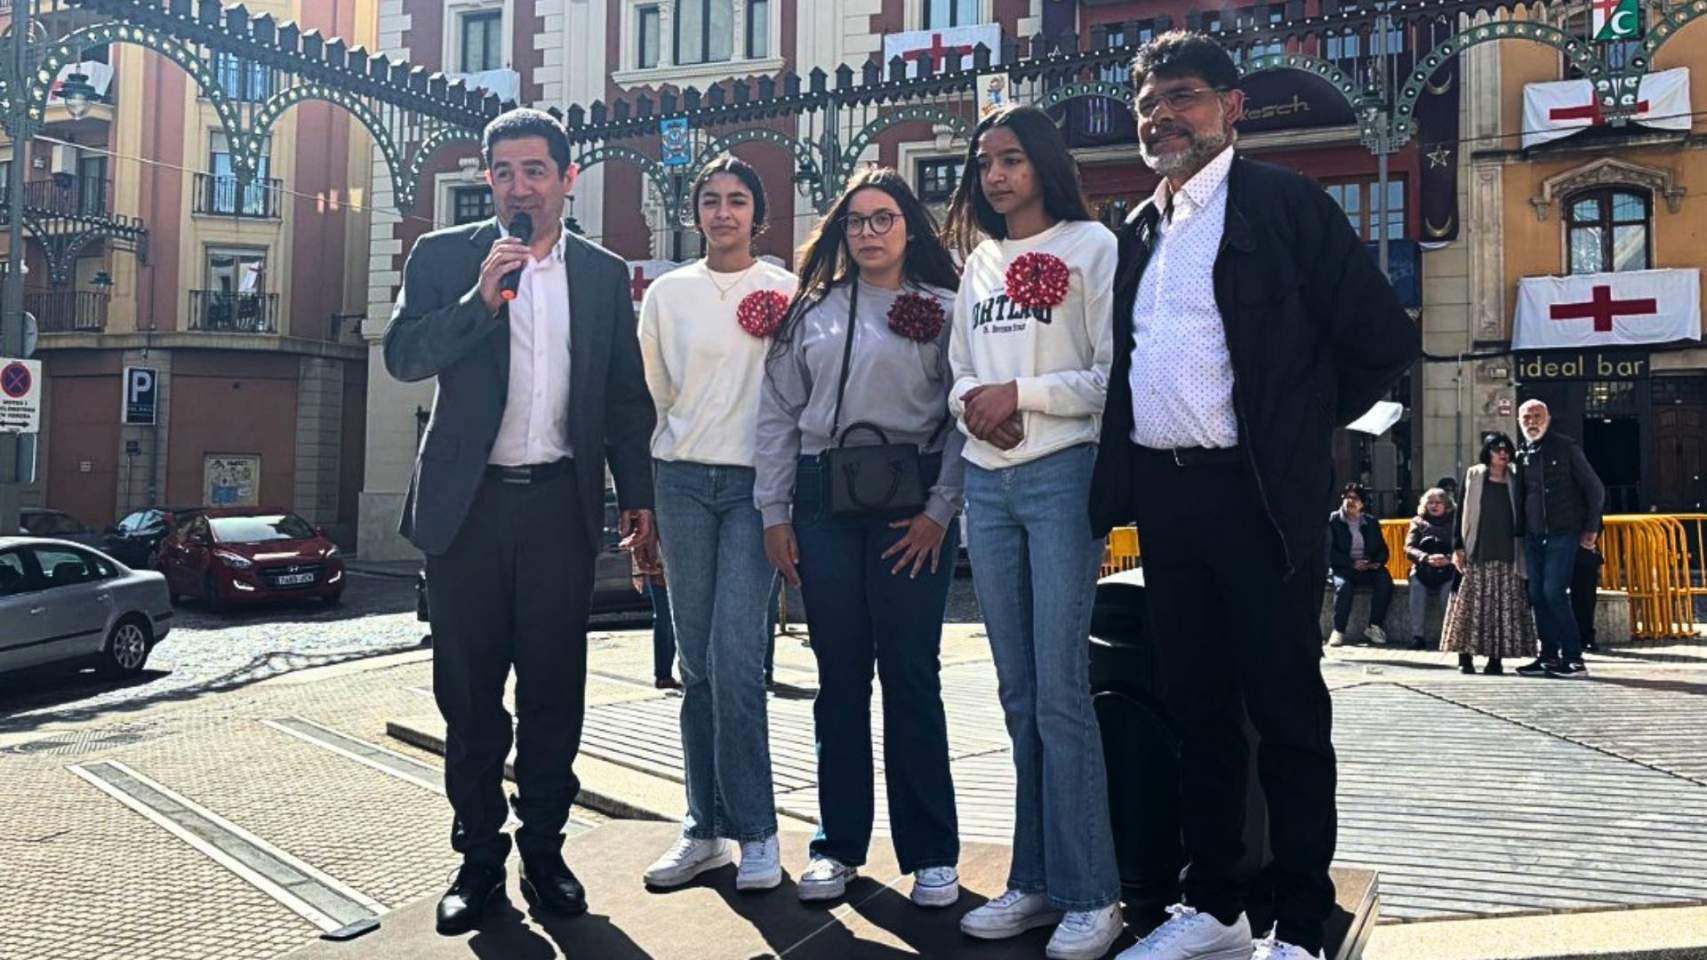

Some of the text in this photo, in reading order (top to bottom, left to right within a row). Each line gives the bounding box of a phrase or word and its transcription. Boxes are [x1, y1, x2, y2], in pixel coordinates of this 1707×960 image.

[1519, 354, 1644, 377] ideal bar
[131, 371, 152, 403] P
